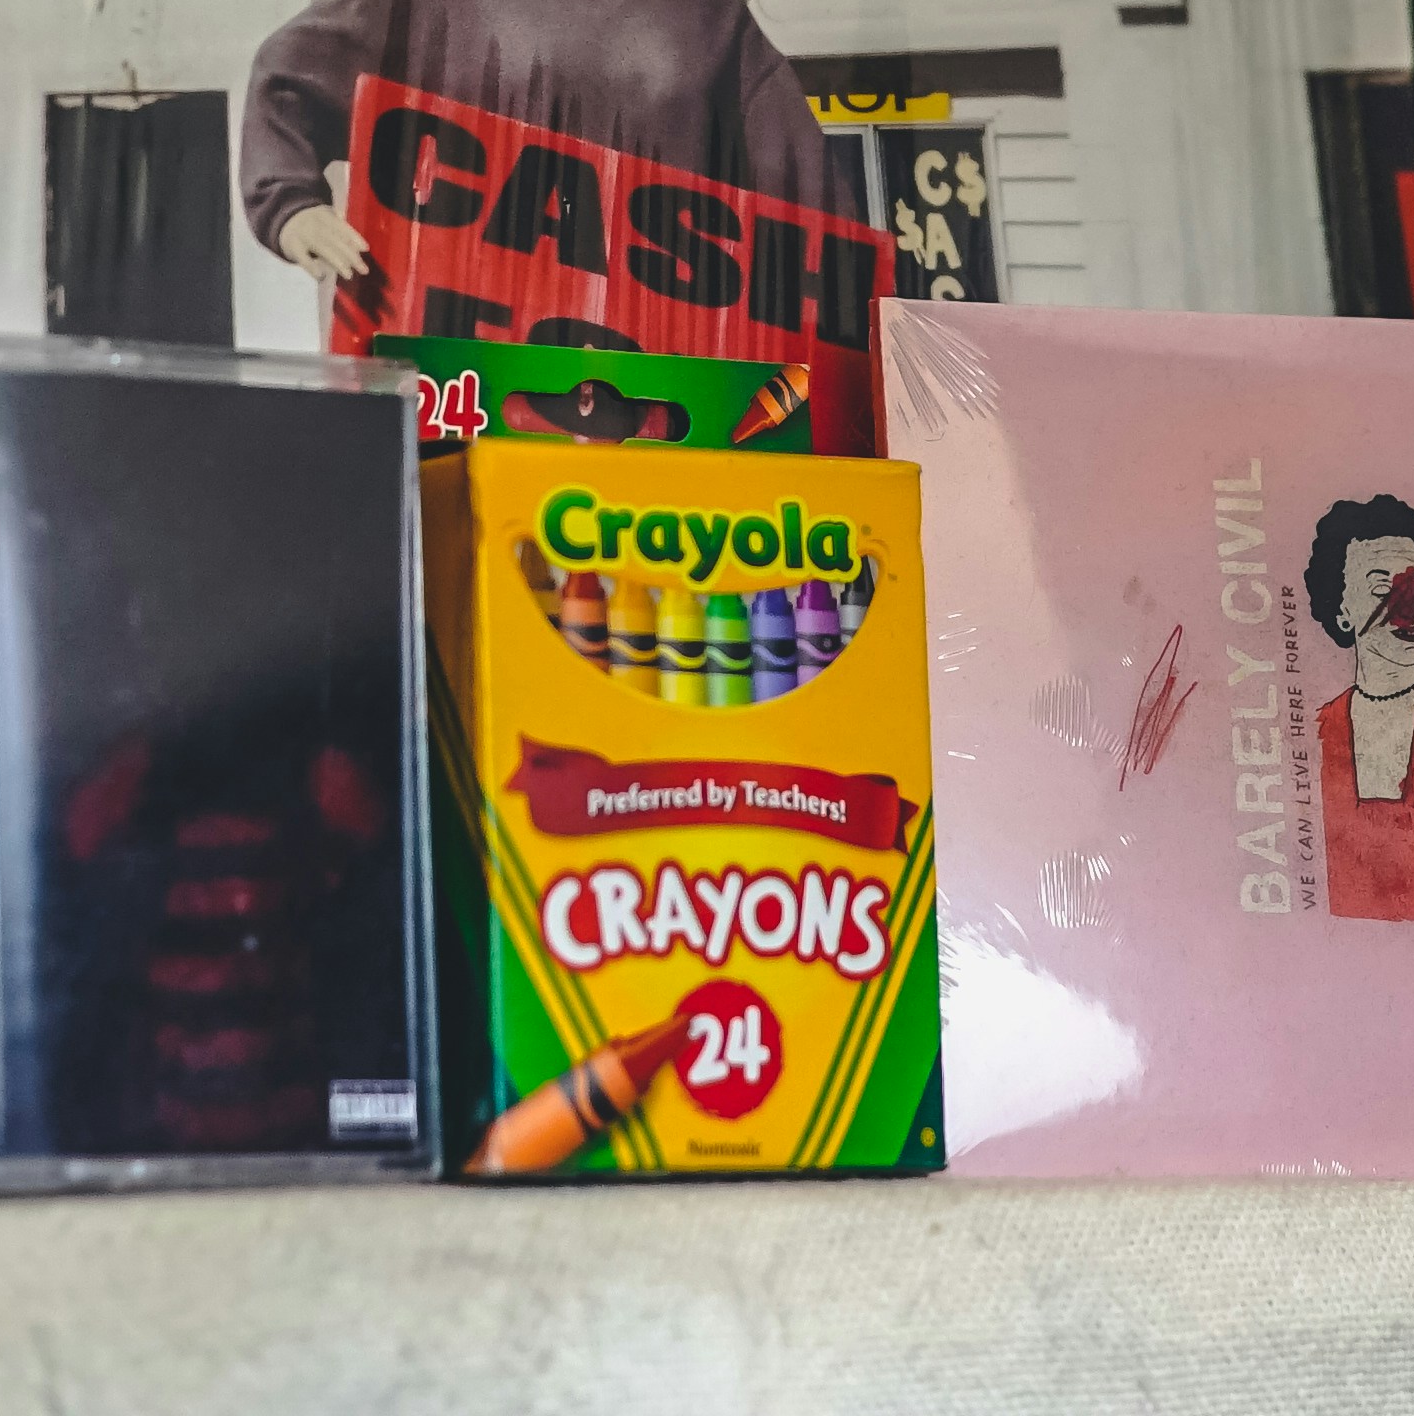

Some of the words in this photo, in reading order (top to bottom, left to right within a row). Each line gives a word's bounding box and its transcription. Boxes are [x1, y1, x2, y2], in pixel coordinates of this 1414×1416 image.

[367, 106, 881, 353] CASH
[418, 370, 488, 438] 24
[543, 489, 854, 582] Crayola
[1213, 457, 1273, 625] CIVIL
[1281, 584, 1300, 674] FOREVER
[1288, 685, 1307, 737] HERE
[588, 778, 703, 818] Preferred
[707, 779, 737, 812] by
[740, 780, 847, 823] Teachers!
[1227, 644, 1291, 914] BARELY
[1295, 754, 1313, 805] LIVE
[1298, 811, 1314, 862] CAN
[542, 866, 887, 973] CRAYONS
[1300, 875, 1318, 910] WE
[688, 1004, 771, 1086] 24
